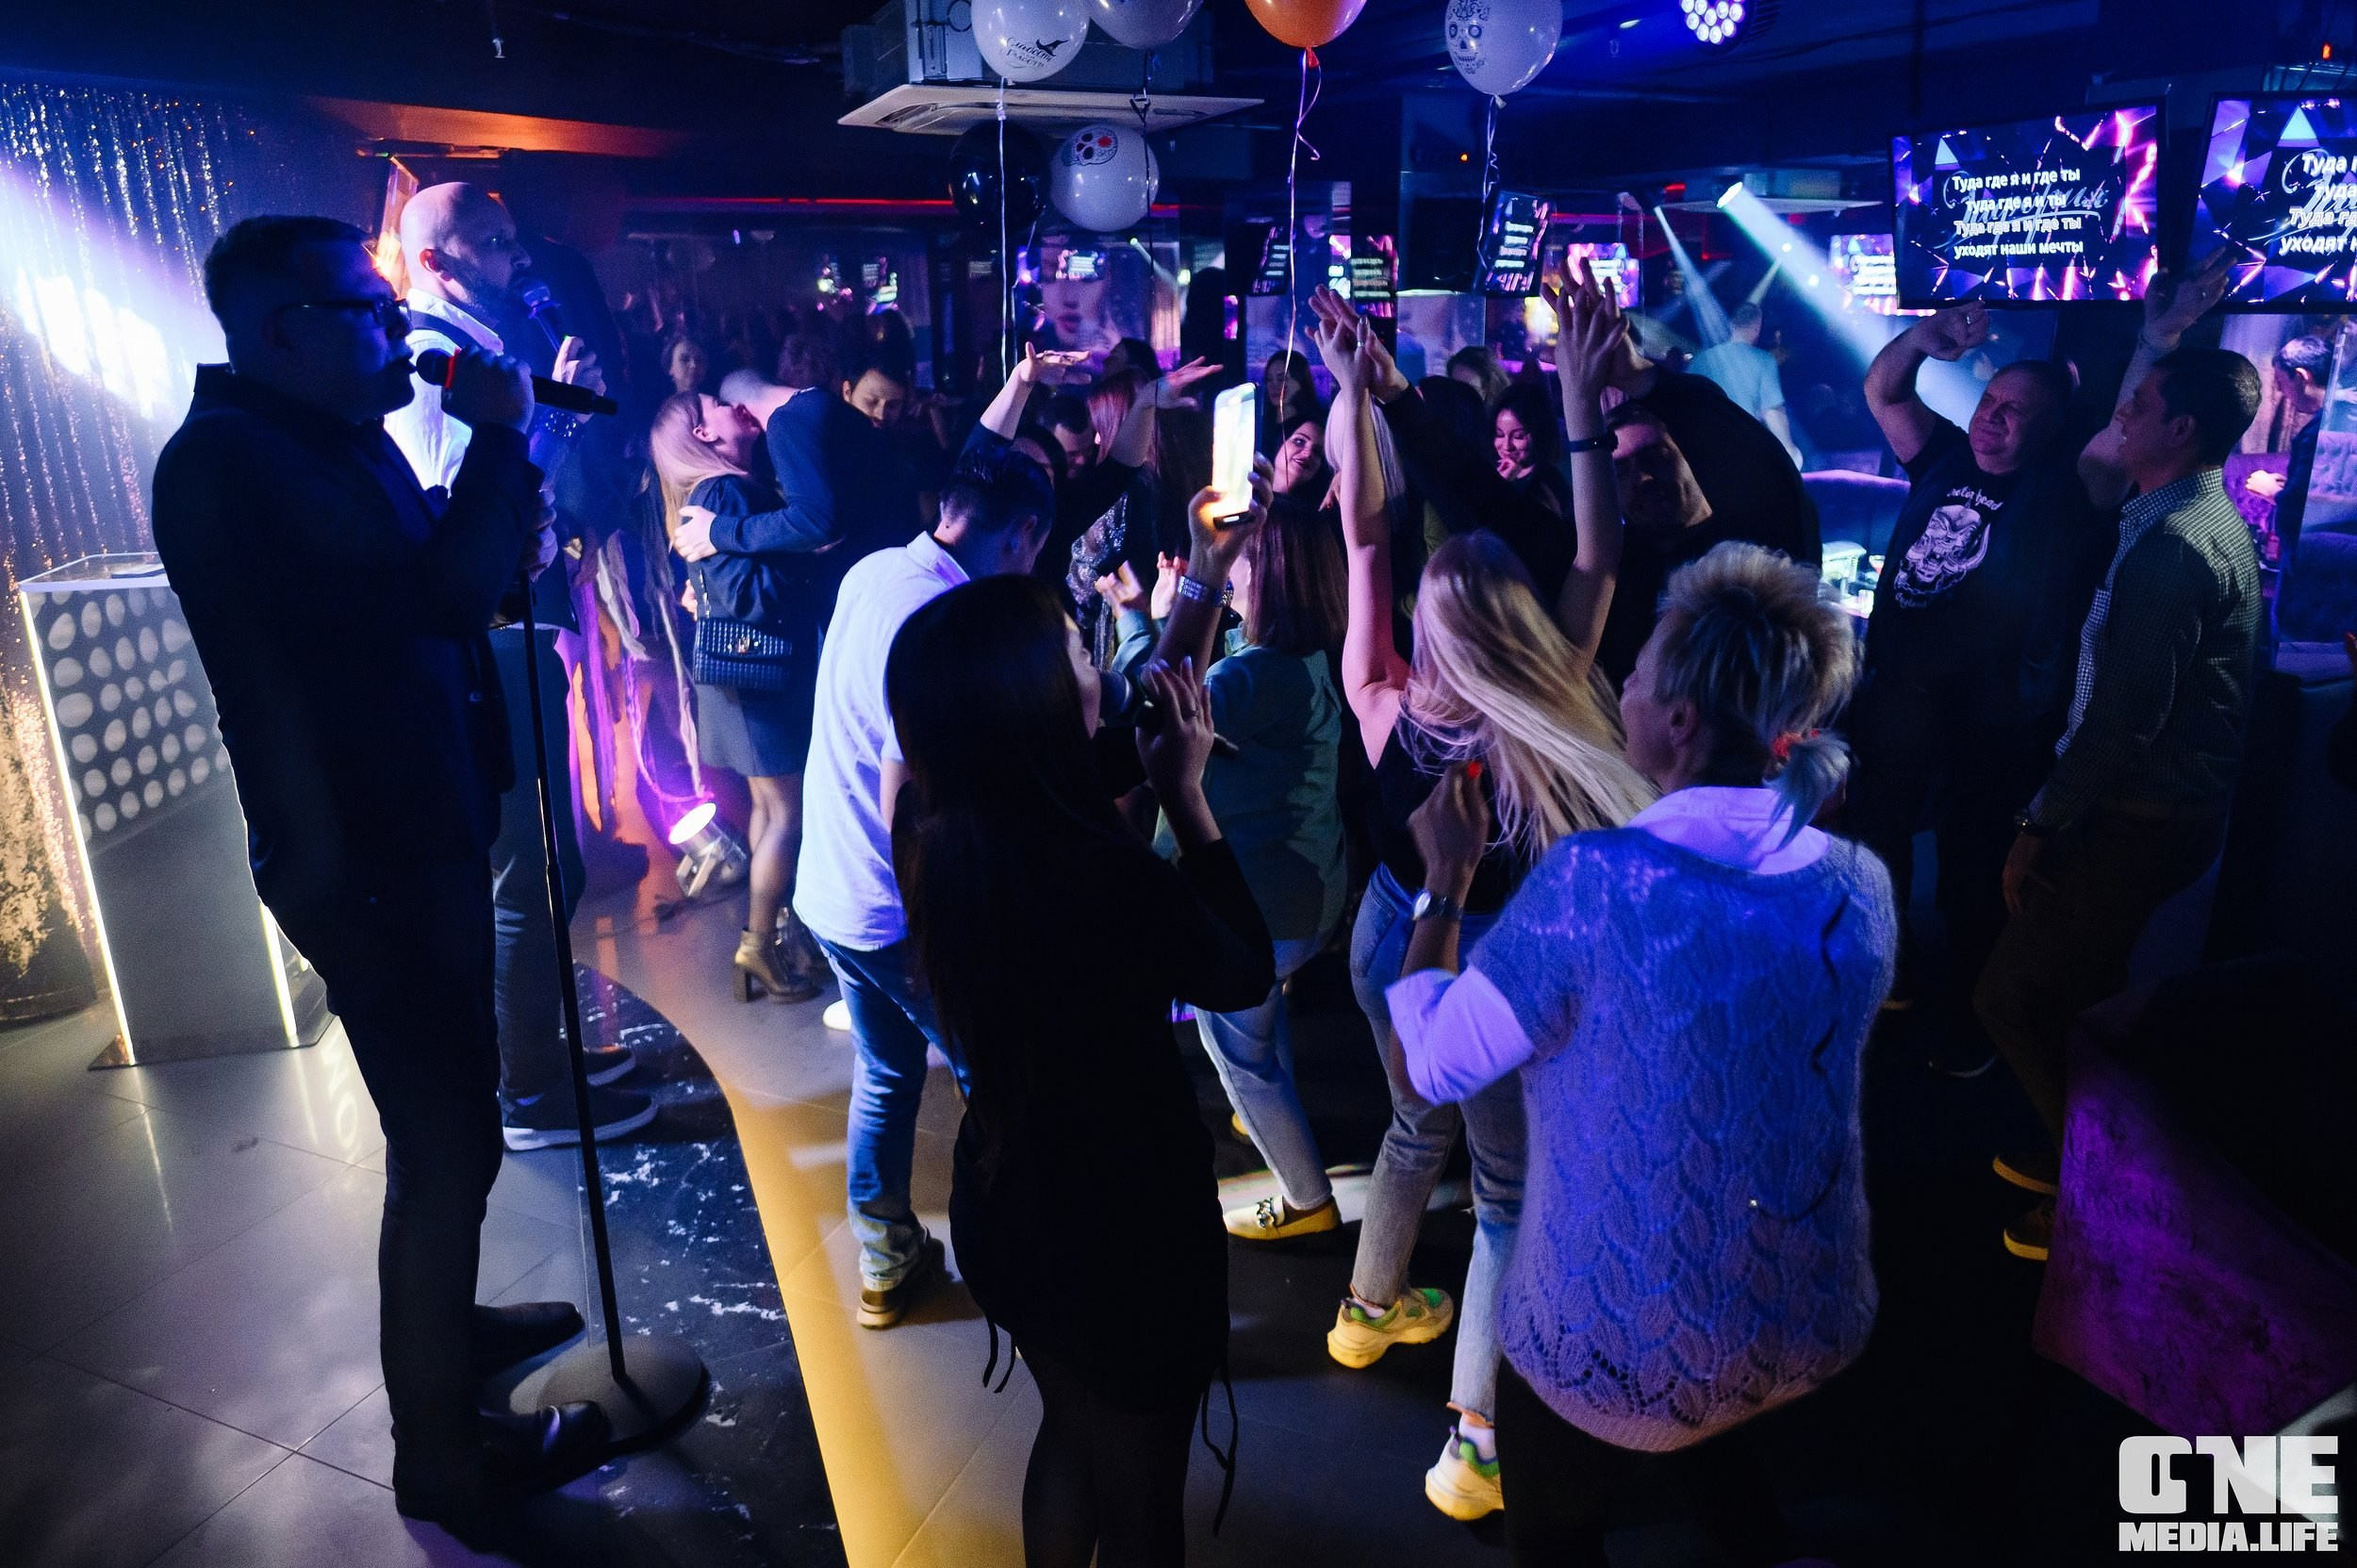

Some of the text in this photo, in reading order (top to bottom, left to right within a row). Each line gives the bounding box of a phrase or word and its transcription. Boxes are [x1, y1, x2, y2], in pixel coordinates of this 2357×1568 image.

[2301, 154, 2348, 177] Туда
[1953, 169, 2080, 192] Туда где я и где ты
[1999, 197, 2020, 211] где
[2023, 197, 2032, 207] я
[2034, 197, 2044, 207] и
[2048, 194, 2067, 206] ты
[1953, 217, 2082, 237] Туда где я и где ты
[2289, 206, 2334, 229] Туда
[1953, 241, 2084, 259] уходят наши мечты
[2279, 236, 2348, 256] уходят
